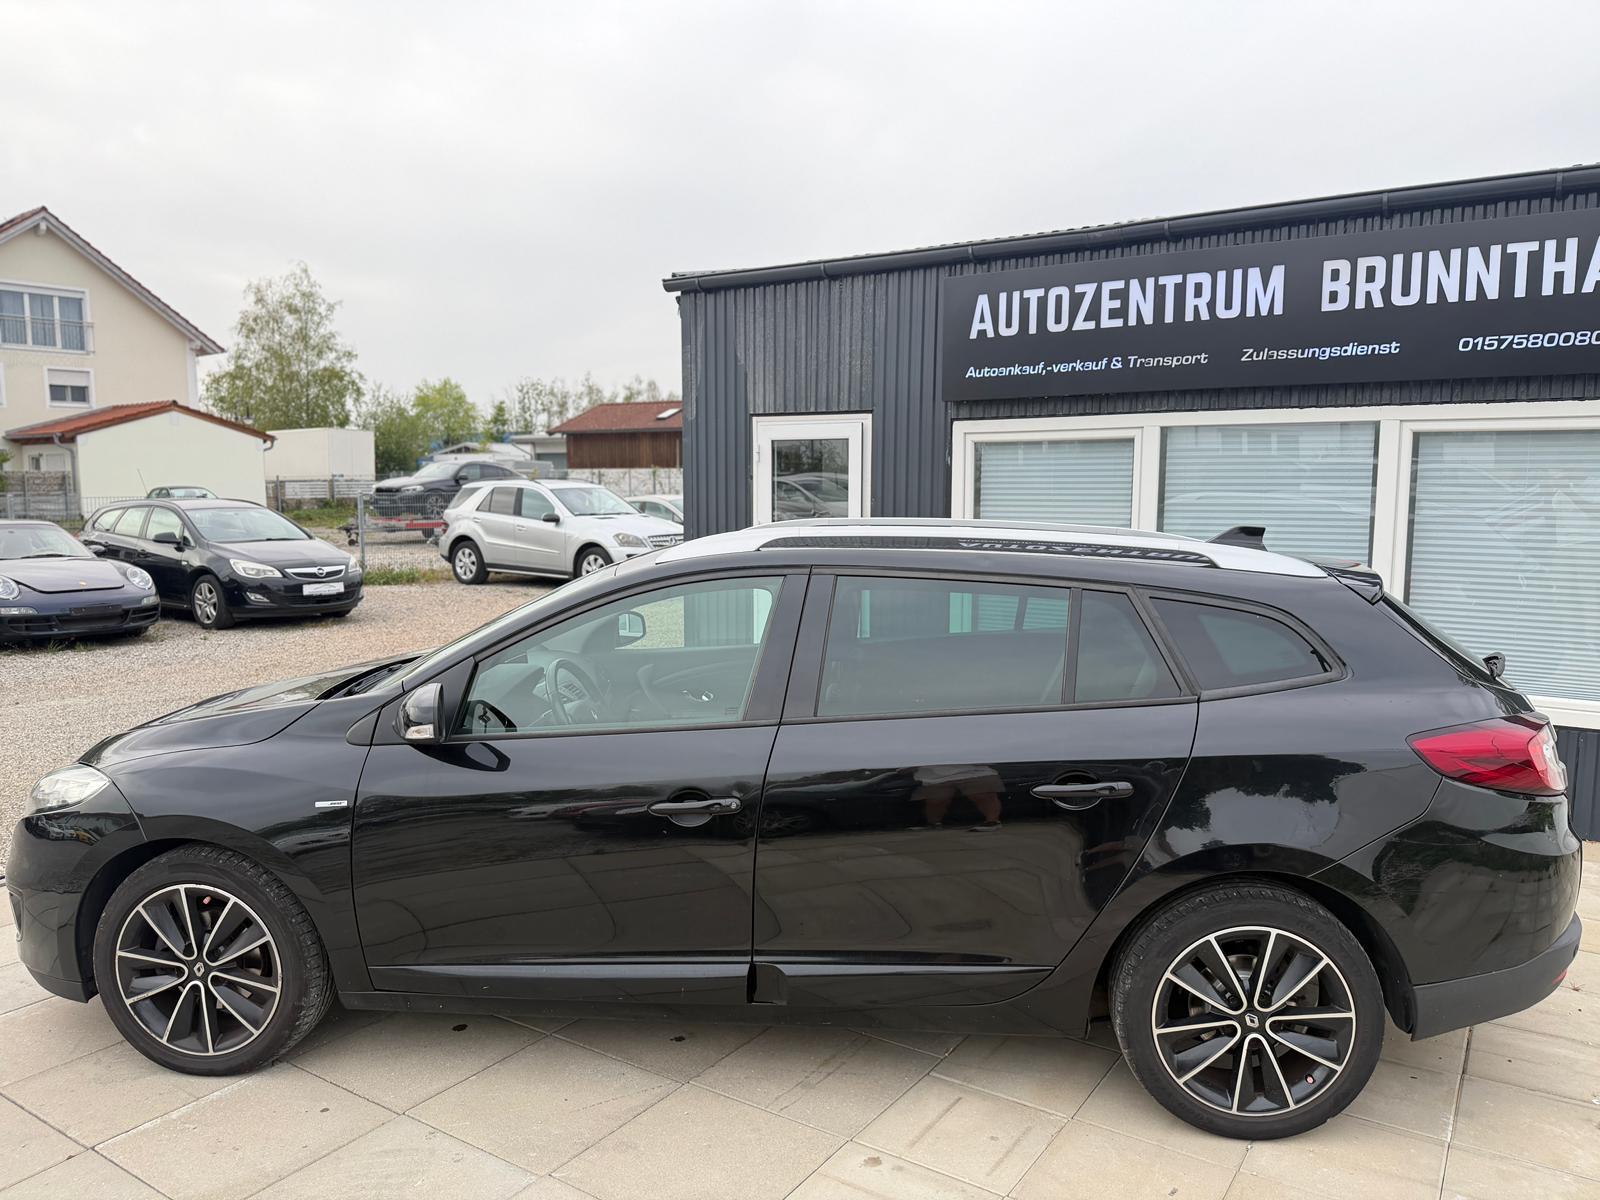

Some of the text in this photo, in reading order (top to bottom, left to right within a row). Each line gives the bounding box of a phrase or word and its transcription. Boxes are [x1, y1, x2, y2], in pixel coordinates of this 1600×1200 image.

[969, 264, 1286, 340] AUTOZENTRUM
[1240, 341, 1401, 362] Zulassungsdienst
[1458, 330, 1600, 352] 0157580080
[965, 352, 1209, 379] Autoankauf,-verkauf & Transport
